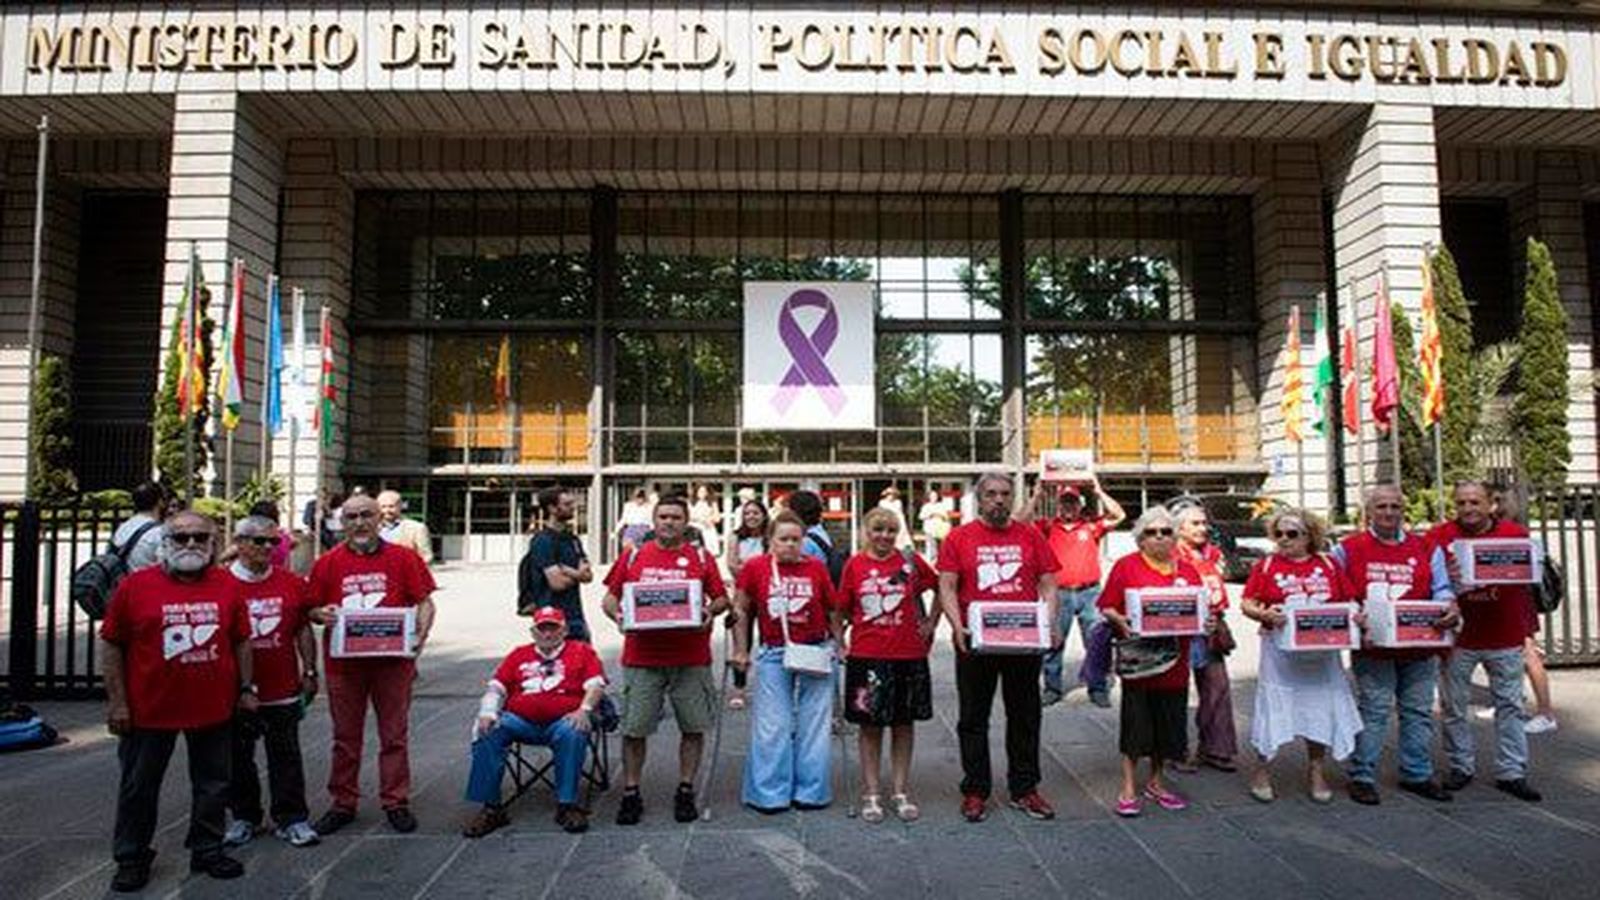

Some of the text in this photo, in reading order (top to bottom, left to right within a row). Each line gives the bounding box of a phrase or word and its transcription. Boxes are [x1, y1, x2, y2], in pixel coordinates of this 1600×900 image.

[28, 23, 1568, 89] MINISTERIO DE SANIDAD, POLITICA SOCIAL E IGUALDAD
